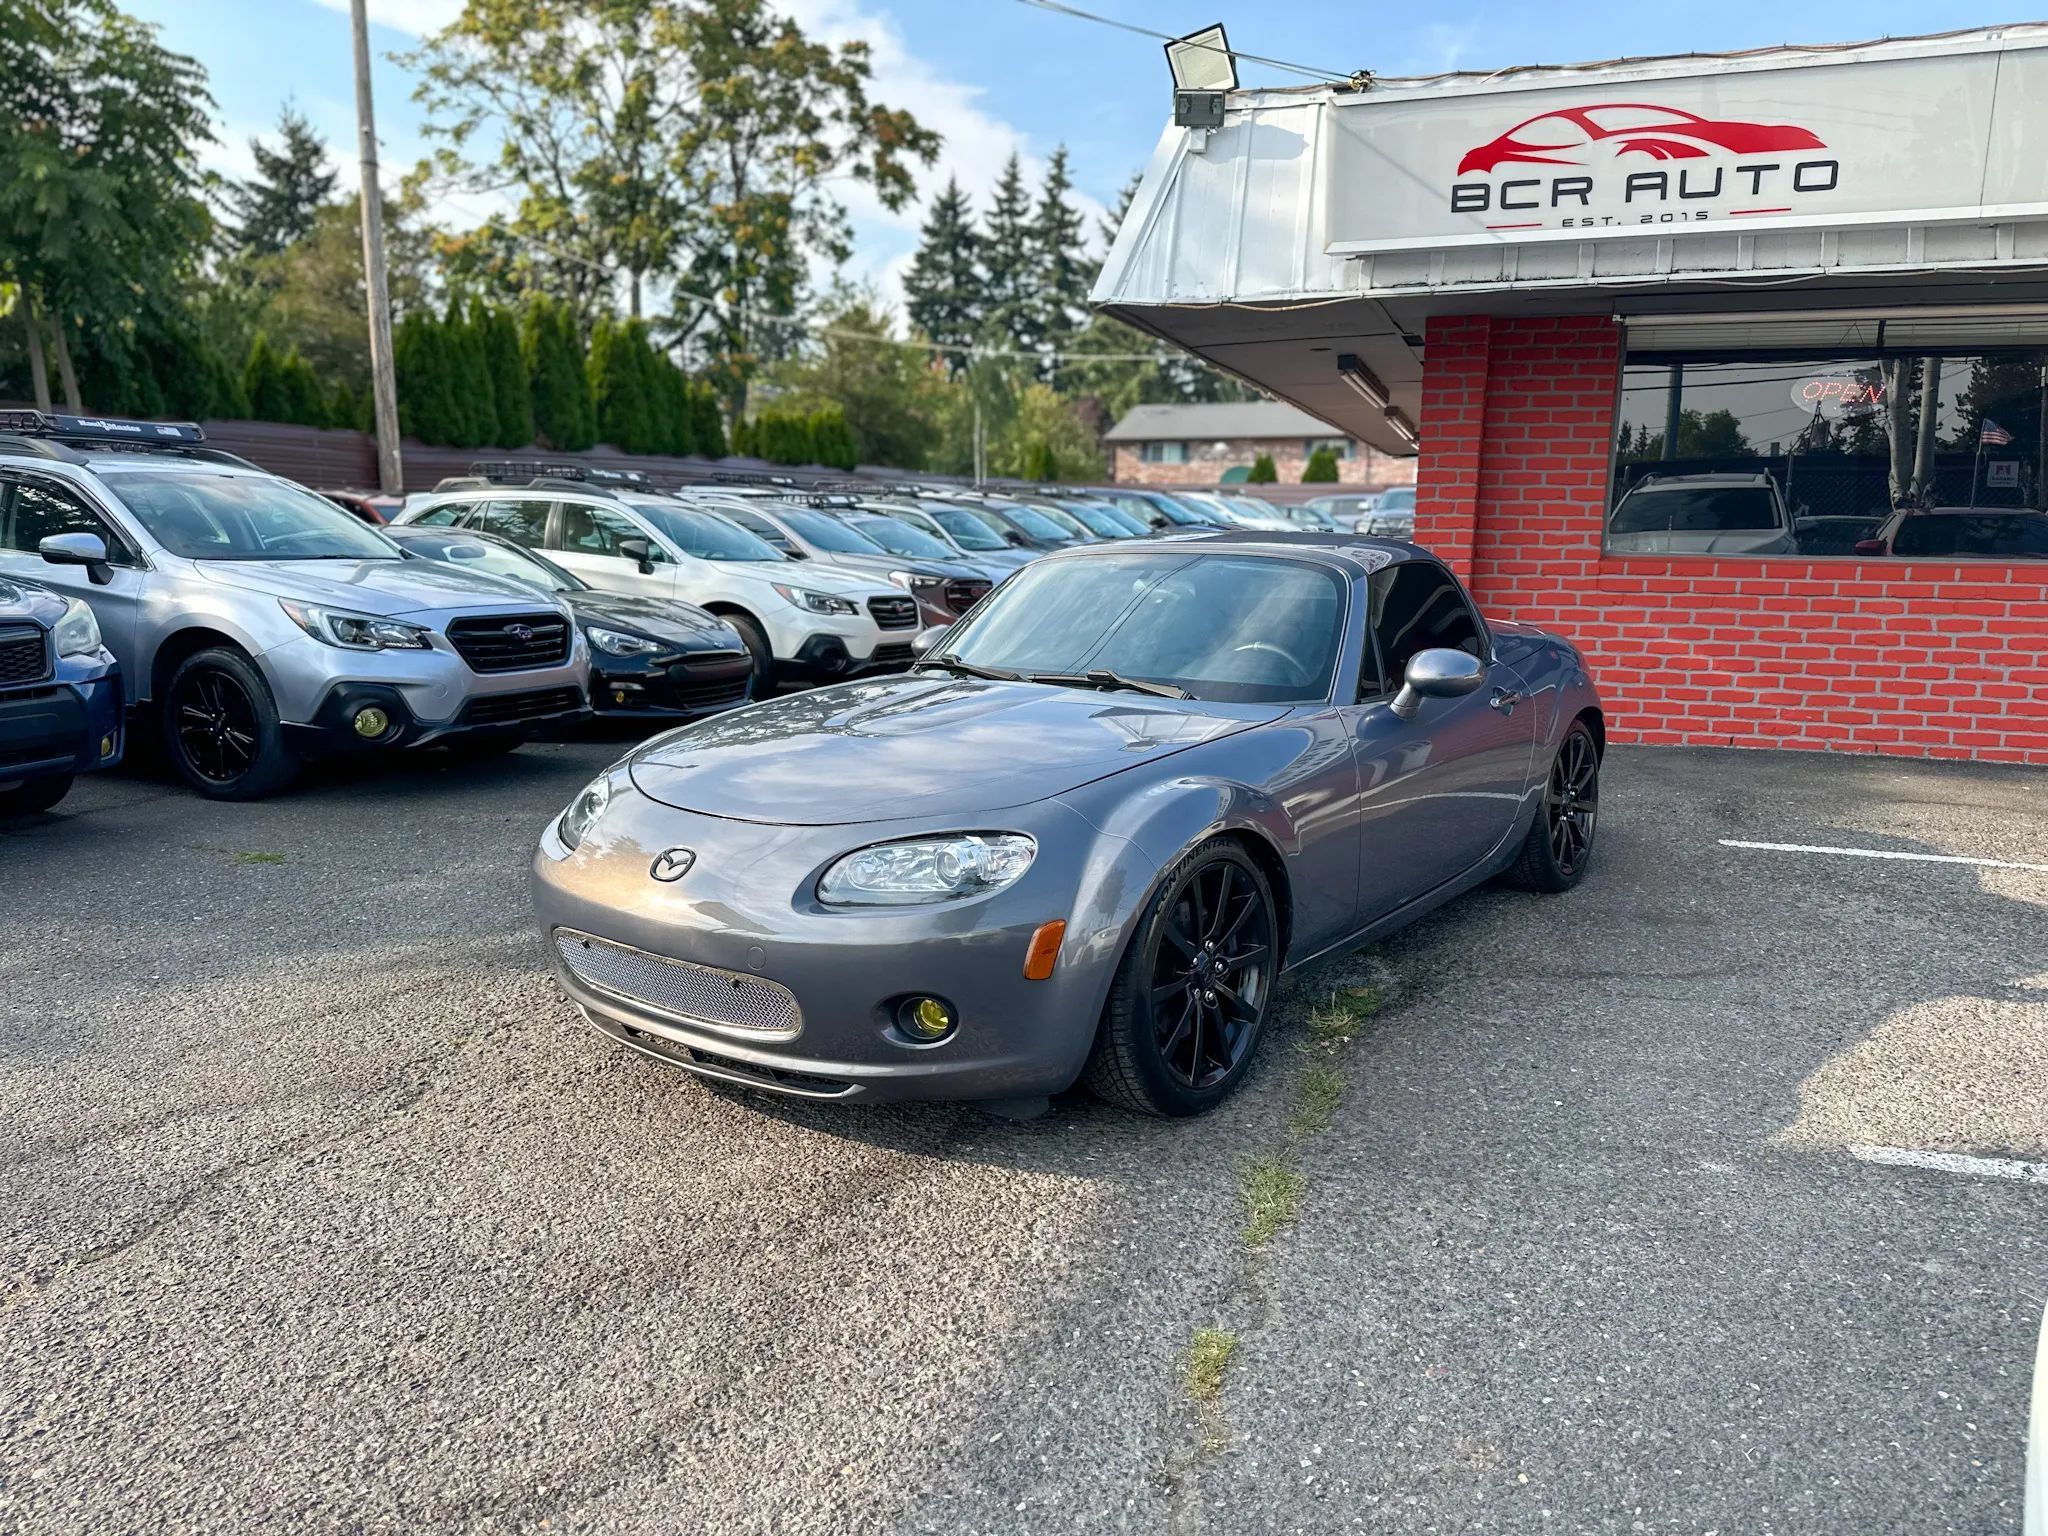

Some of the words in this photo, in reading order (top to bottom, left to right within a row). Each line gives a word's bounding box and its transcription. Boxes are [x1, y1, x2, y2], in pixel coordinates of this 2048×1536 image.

[1451, 177, 1594, 213] BCR
[1625, 160, 1839, 204] AUTO
[1562, 216, 1623, 228] EST.
[1640, 210, 1709, 225] 2015
[1802, 381, 1886, 404] OPEN
